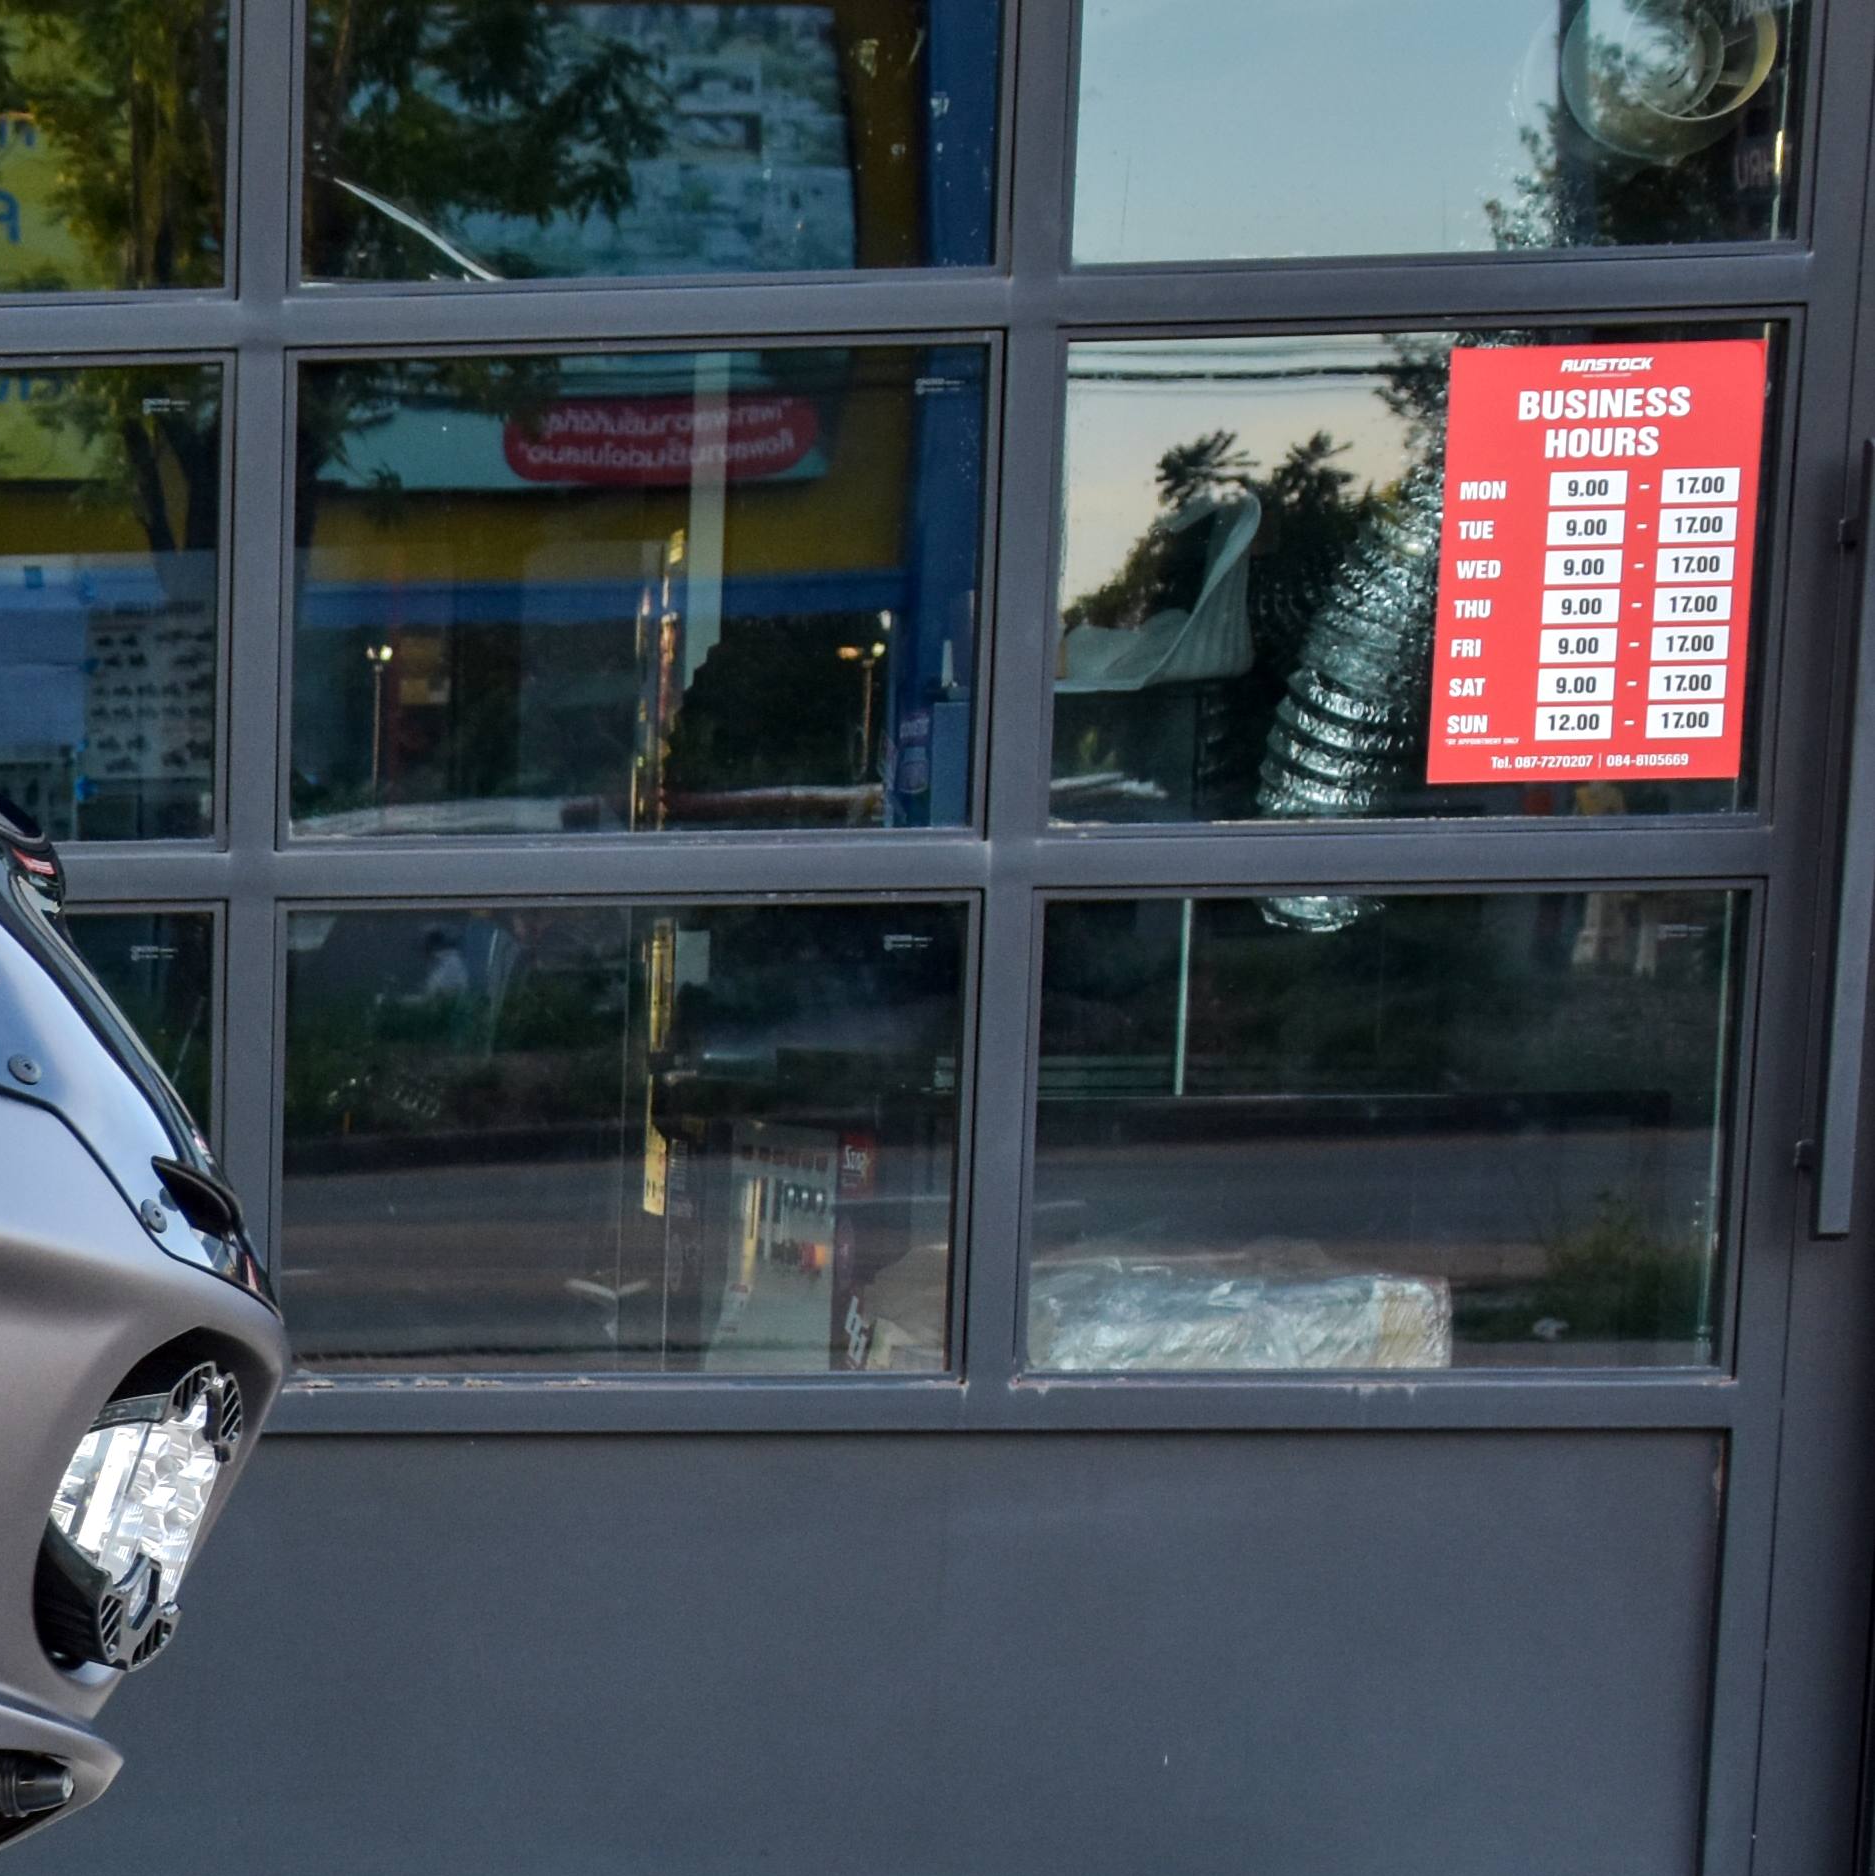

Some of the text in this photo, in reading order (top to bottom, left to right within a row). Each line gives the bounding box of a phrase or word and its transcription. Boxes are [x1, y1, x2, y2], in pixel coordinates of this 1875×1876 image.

[1518, 386, 1692, 421] BUSINESS
[1544, 426, 1660, 459] HOURS
[1460, 476, 1726, 500] MON 9.00 17.00
[1459, 516, 1724, 540] TUE 9.00 17.00
[1456, 555, 1721, 579] WED 9.00 17.00
[1454, 595, 1719, 619] THU 9.00 17.00
[1451, 634, 1716, 658] FRI 9.00 17.00
[1448, 673, 1712, 697] SAT 9.00 17.00
[1447, 711, 1710, 734] SUN 12.00 17.00
[1491, 752, 1689, 769] Tel. 087-7270207 084-8105669
